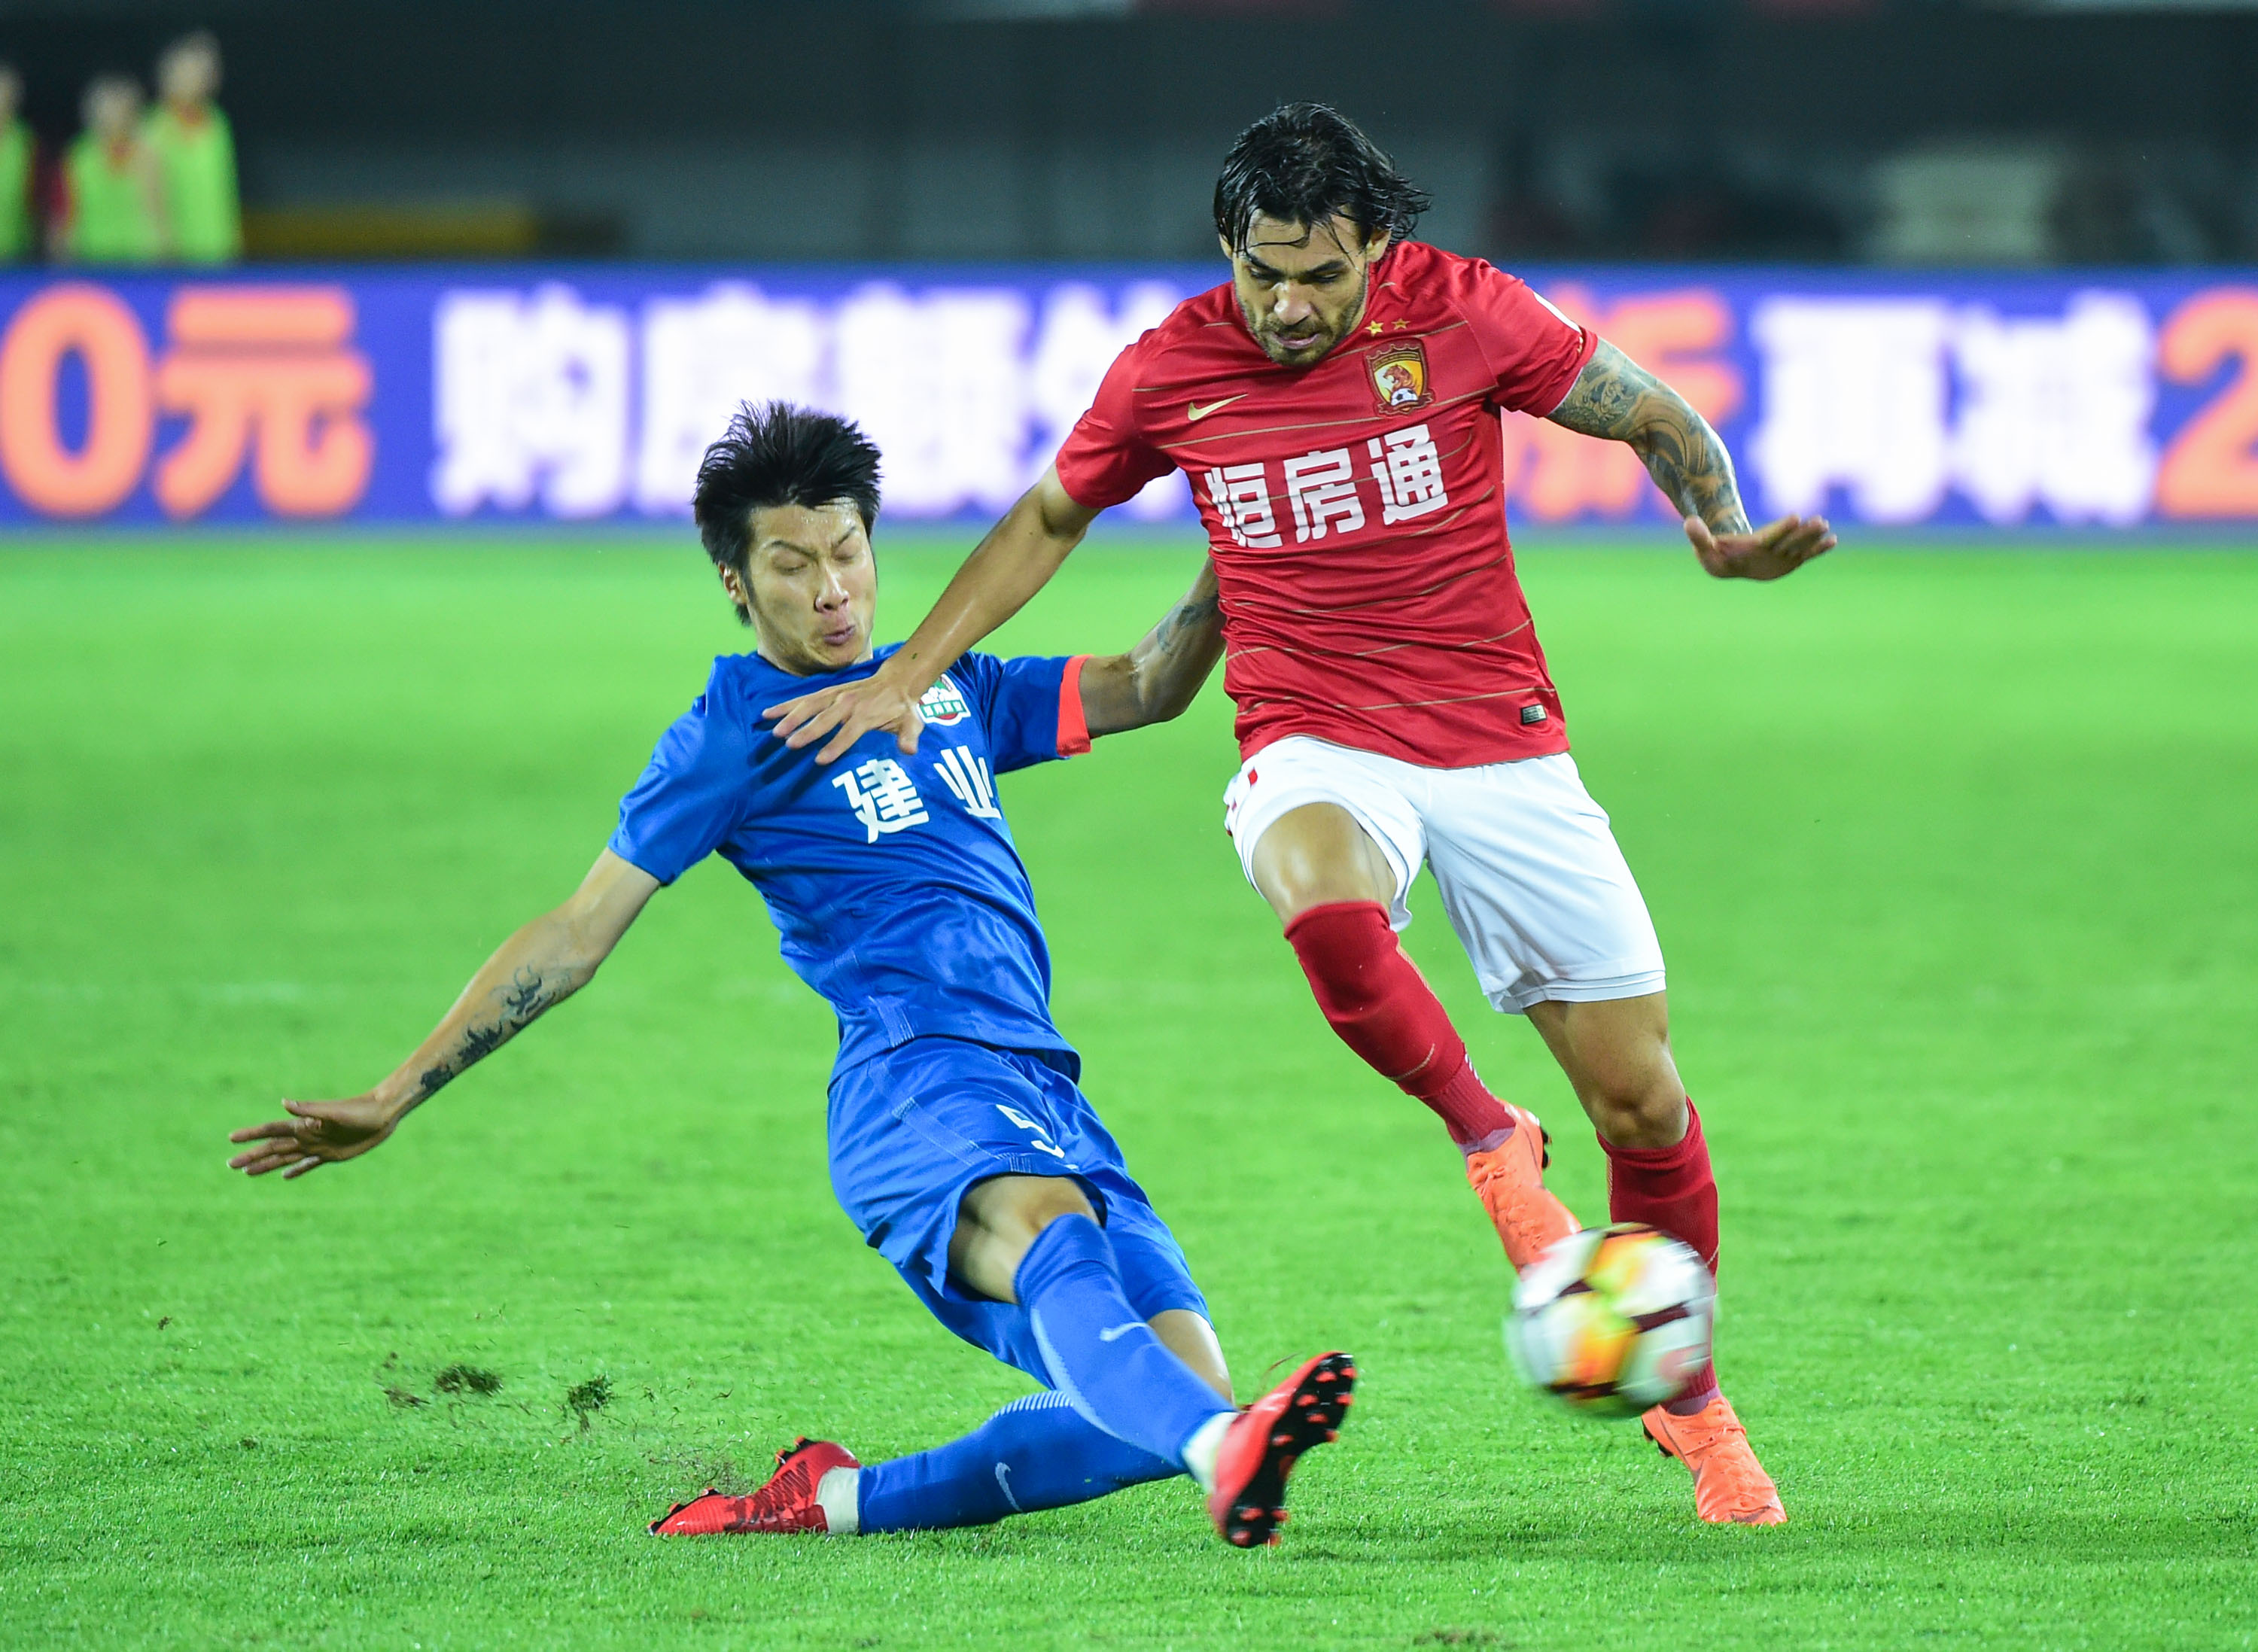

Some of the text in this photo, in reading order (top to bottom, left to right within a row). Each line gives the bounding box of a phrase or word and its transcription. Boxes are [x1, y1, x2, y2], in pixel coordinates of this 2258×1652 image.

[1204, 424, 1448, 548] 恒房通
[832, 745, 1003, 844] 建业
